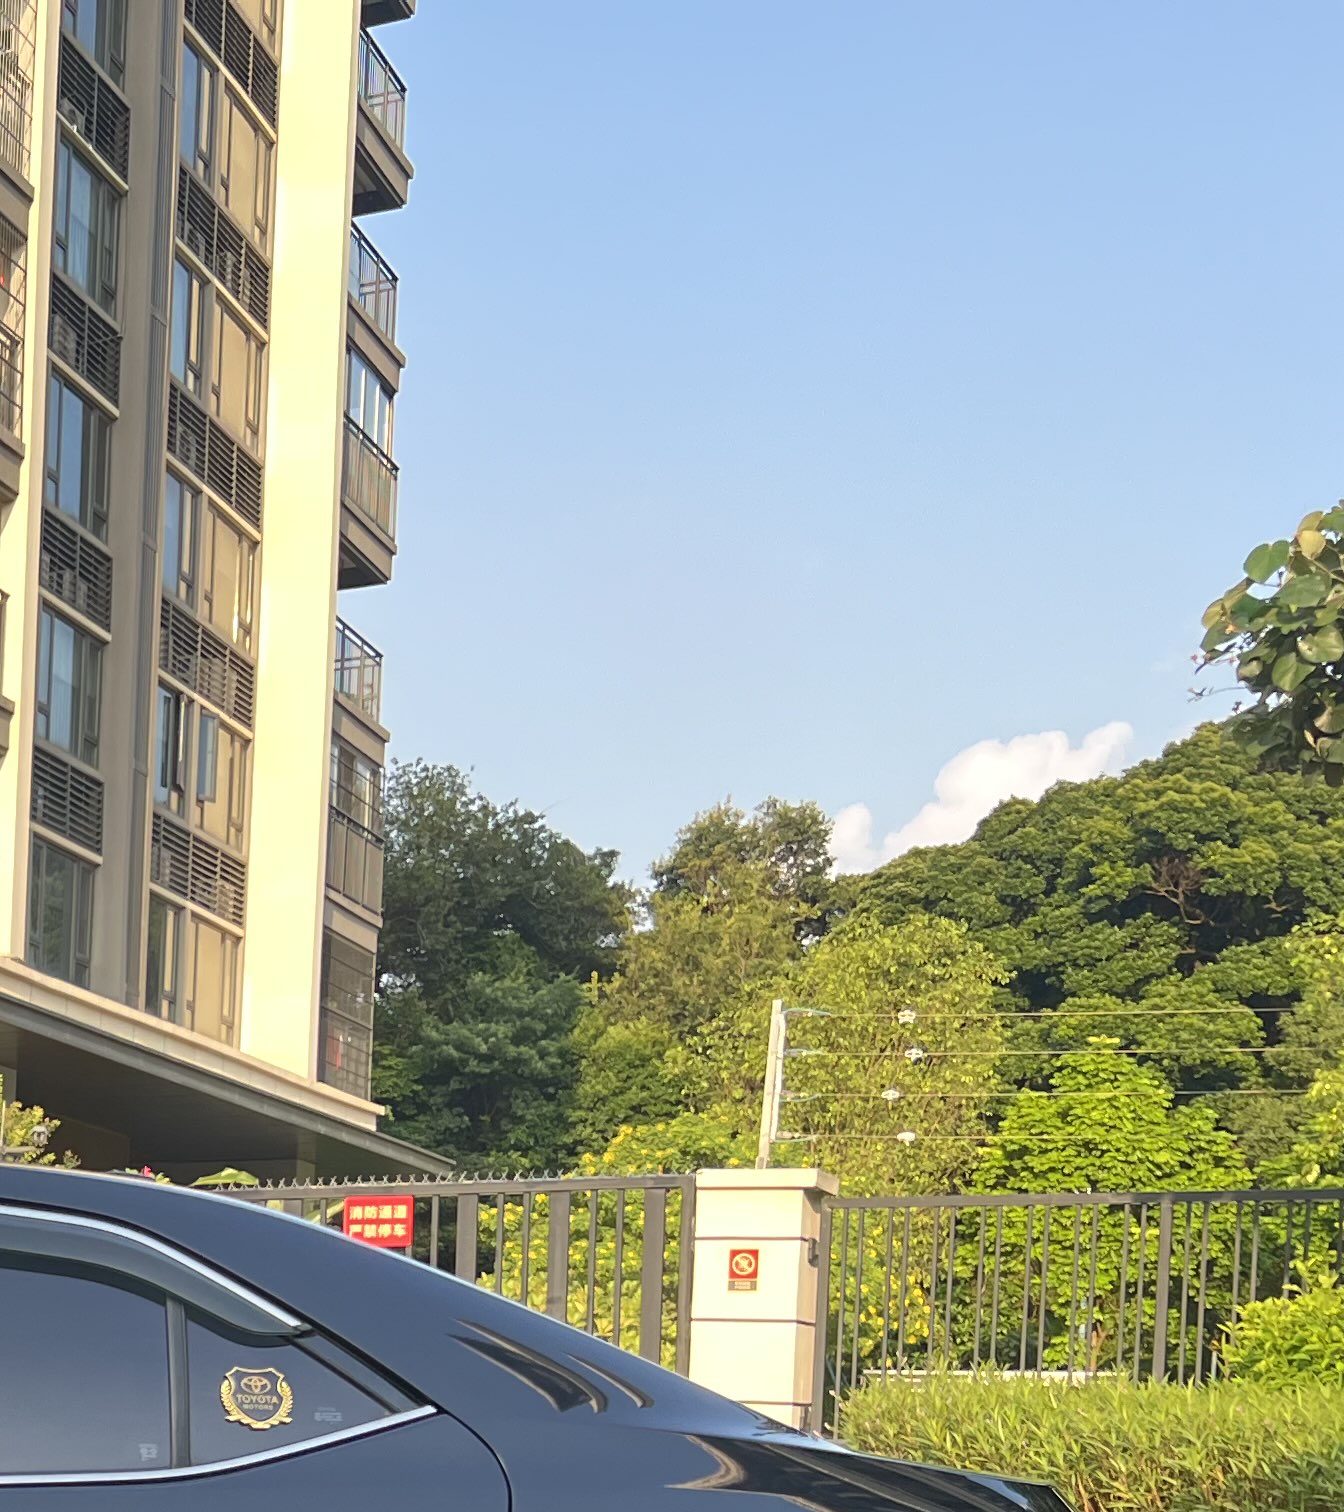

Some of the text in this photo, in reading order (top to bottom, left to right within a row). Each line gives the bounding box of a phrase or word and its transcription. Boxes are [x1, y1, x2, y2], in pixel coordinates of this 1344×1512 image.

[349, 1223, 408, 1238] 严禁停车
[236, 1394, 279, 1404] TOYOTA
